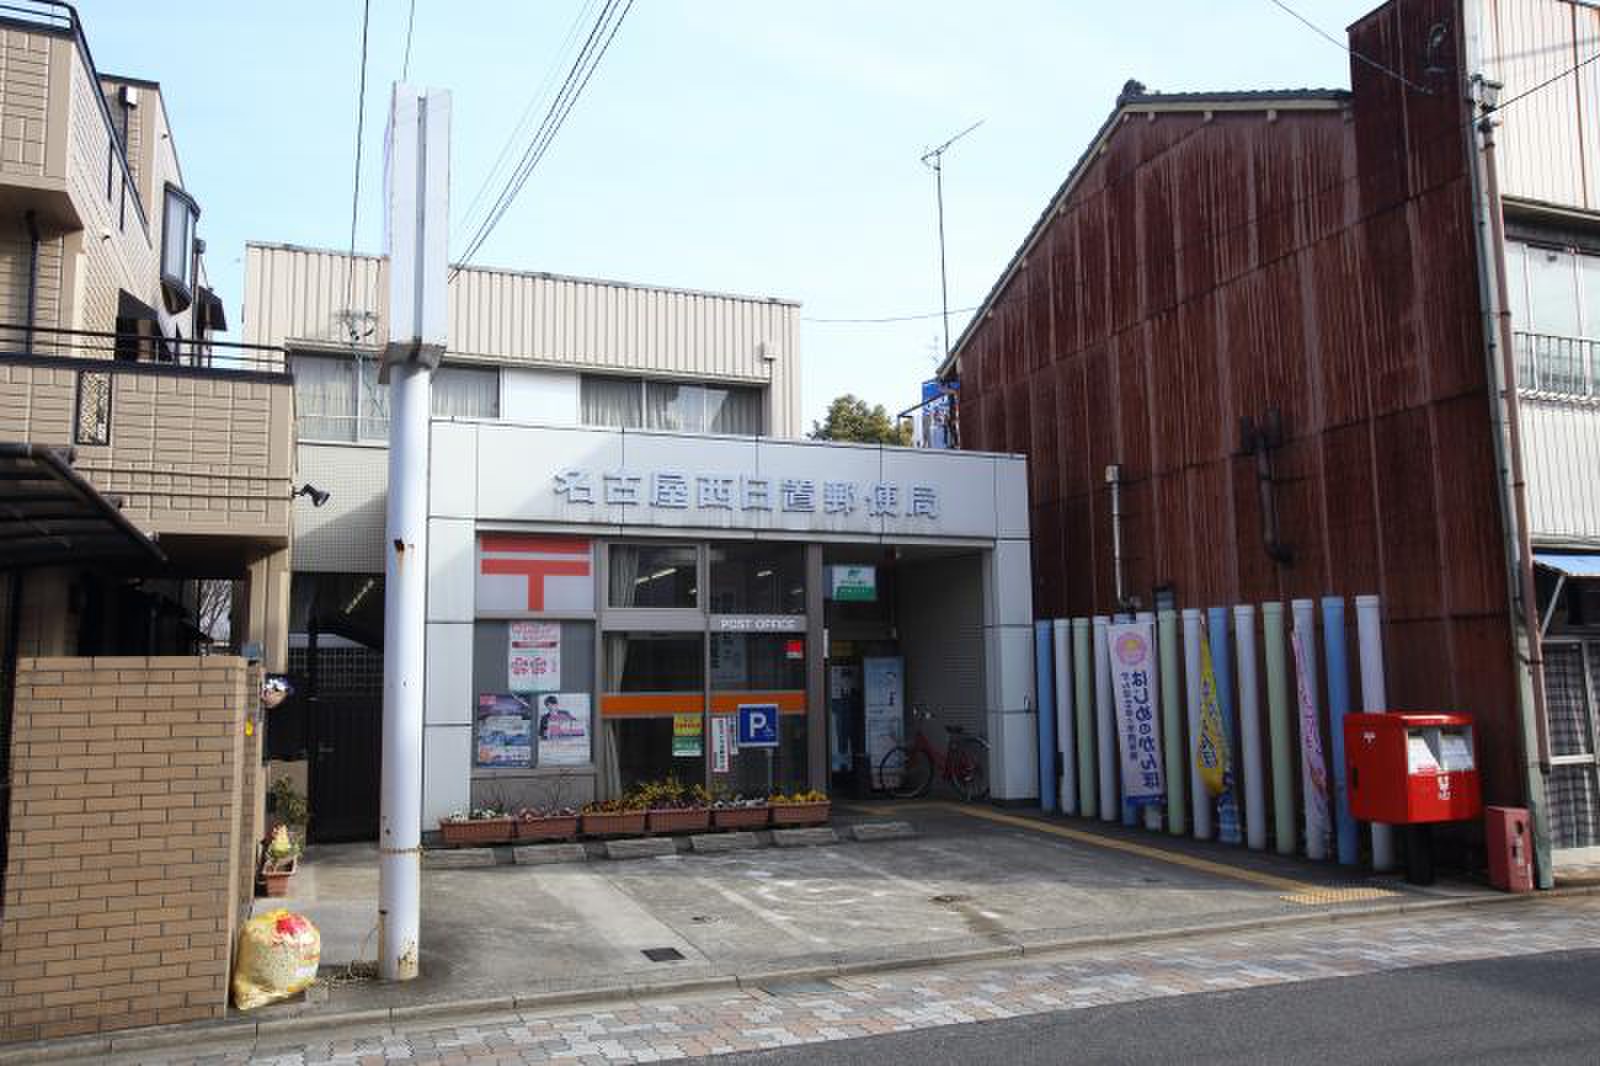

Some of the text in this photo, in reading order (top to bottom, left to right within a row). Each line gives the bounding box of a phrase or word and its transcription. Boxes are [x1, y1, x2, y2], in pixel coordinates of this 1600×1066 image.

[553, 469, 940, 520] 名古屋西日置郵便局
[720, 618, 796, 630] POST OFFICE
[749, 711, 767, 738] P
